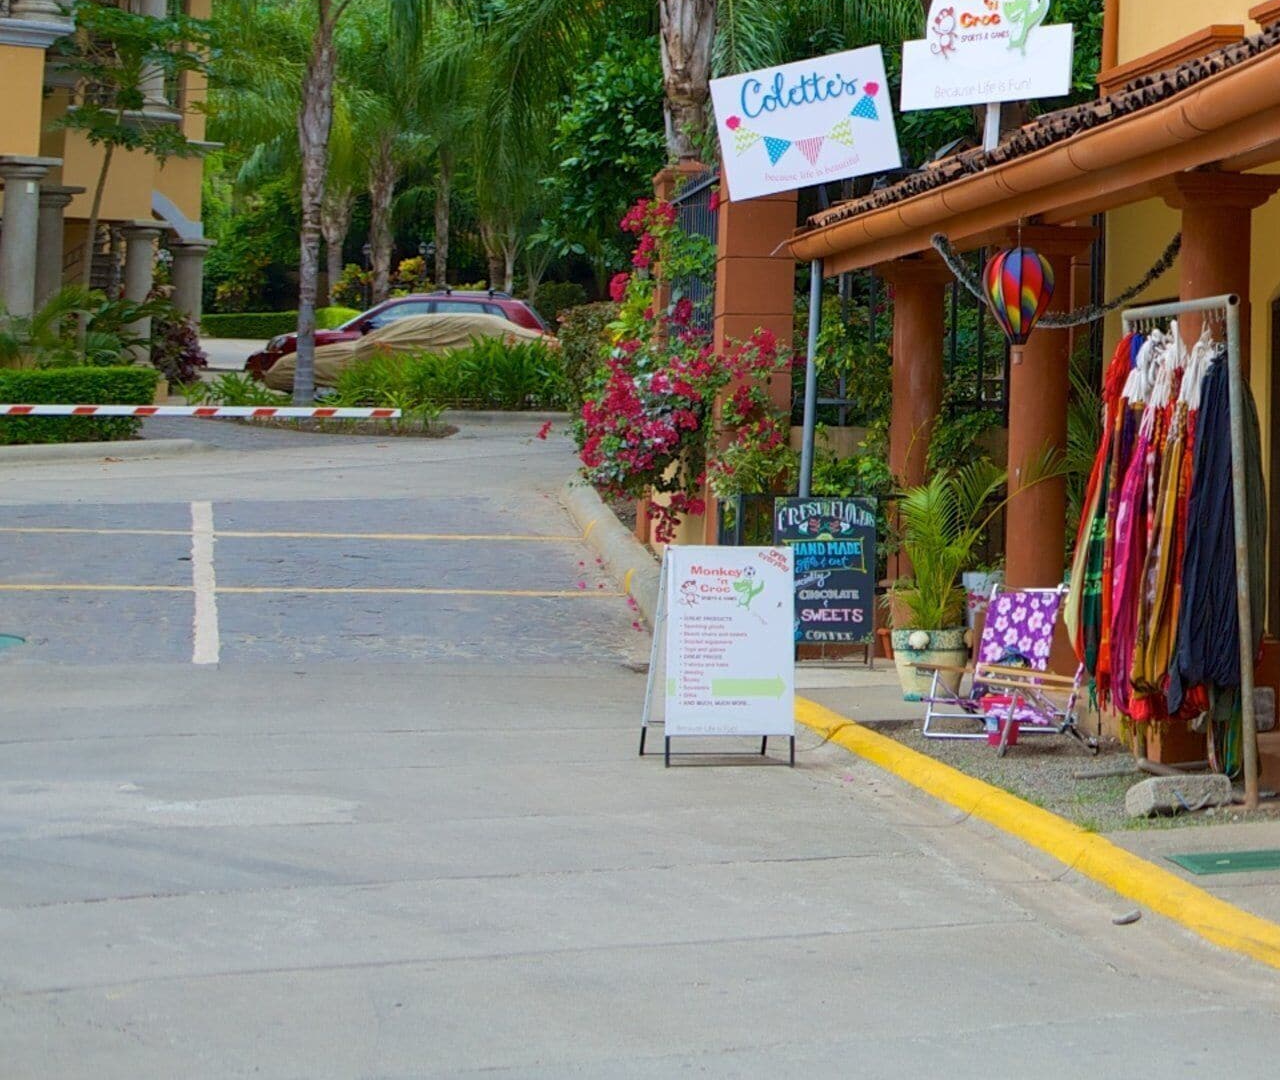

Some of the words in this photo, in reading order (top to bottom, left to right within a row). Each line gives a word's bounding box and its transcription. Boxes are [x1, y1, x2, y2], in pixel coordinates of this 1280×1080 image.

[960, 13, 1001, 28] Croc
[960, 32, 983, 42] SPORTS
[991, 30, 1010, 39] GAMES
[741, 72, 859, 119] Colette's
[827, 542, 861, 555] MADE
[690, 565, 743, 578] Monkey
[700, 584, 731, 593] Croc
[799, 589, 859, 601] CHOCOLATE
[801, 608, 863, 622] SWEETS
